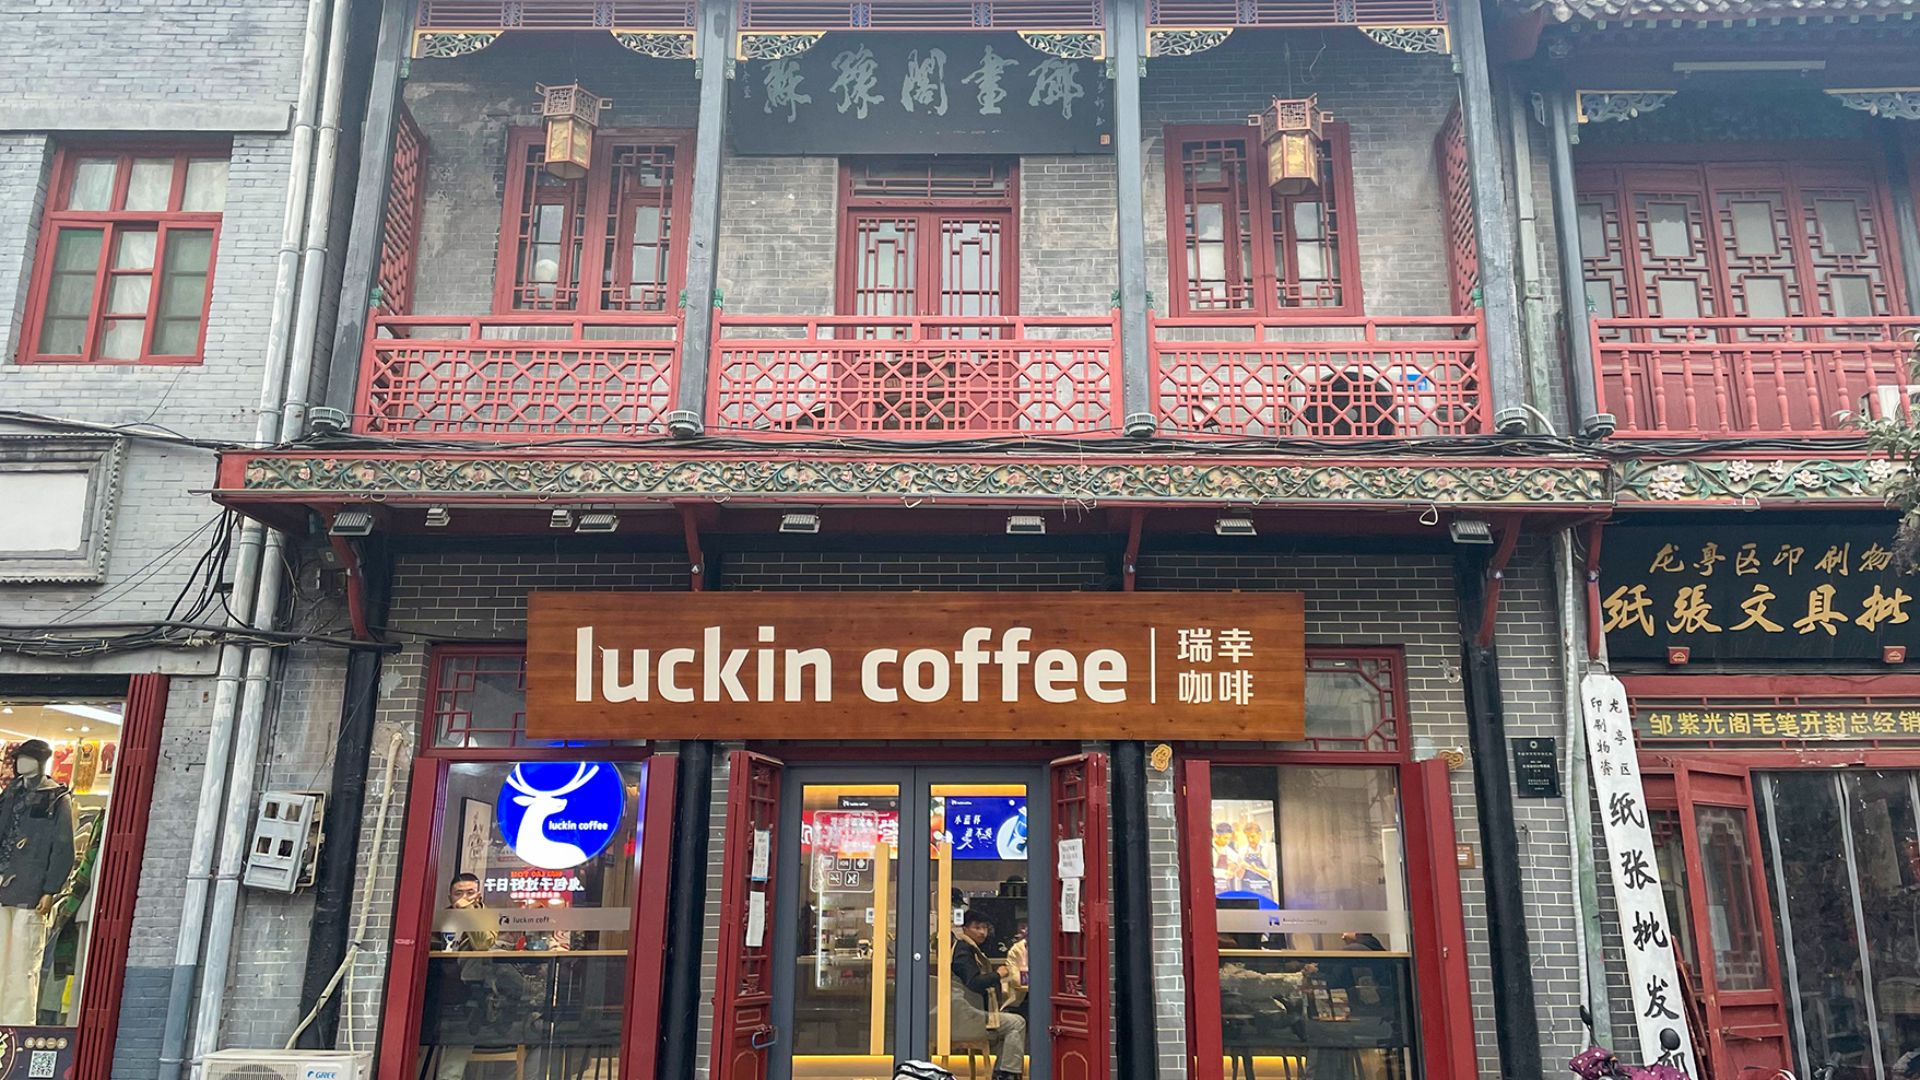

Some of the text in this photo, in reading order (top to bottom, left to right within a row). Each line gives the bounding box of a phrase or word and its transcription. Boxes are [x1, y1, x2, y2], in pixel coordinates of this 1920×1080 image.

[1649, 542, 1920, 577] 龙亭区印刷物
[576, 625, 1128, 702] luckin coffee
[1177, 627, 1254, 664] 瑞幸
[1177, 669, 1254, 706] 咖啡
[1590, 697, 1614, 776] 印刷物资
[1608, 698, 1632, 776] 龙亭区
[1650, 711, 1920, 736] 邹紫光阁毛笔开封总经销
[548, 820, 608, 830] luckin coffee
